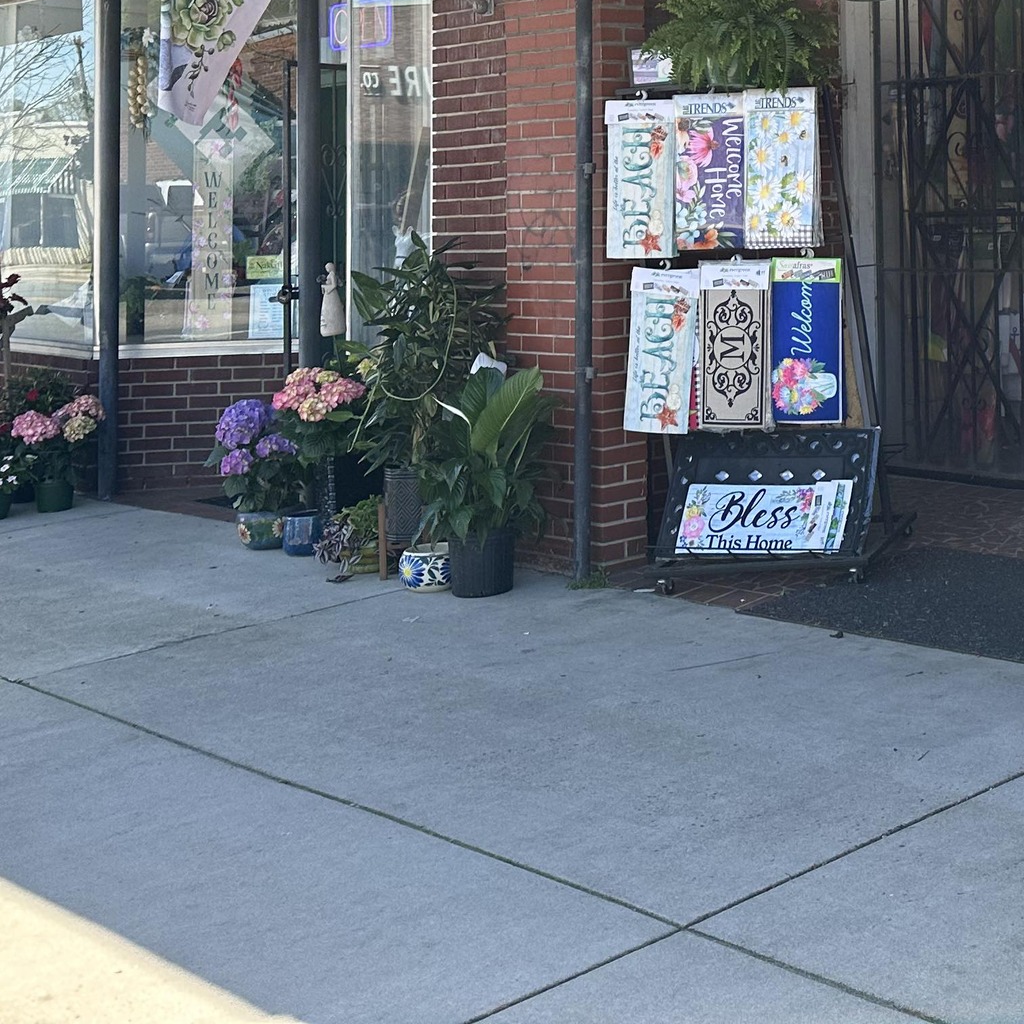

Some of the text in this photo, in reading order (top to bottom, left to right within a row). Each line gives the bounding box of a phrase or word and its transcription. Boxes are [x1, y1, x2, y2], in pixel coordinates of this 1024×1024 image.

[333, 5, 387, 45] OEN
[688, 102, 727, 115] TRENDS
[760, 96, 797, 109] TRENDS
[622, 126, 656, 249] BEACH
[204, 171, 222, 310] WELCOME
[790, 280, 813, 356] Welcom
[640, 296, 677, 422] BEACH
[719, 335, 745, 362] M
[708, 488, 801, 533] Bless
[705, 534, 792, 550] This Home
